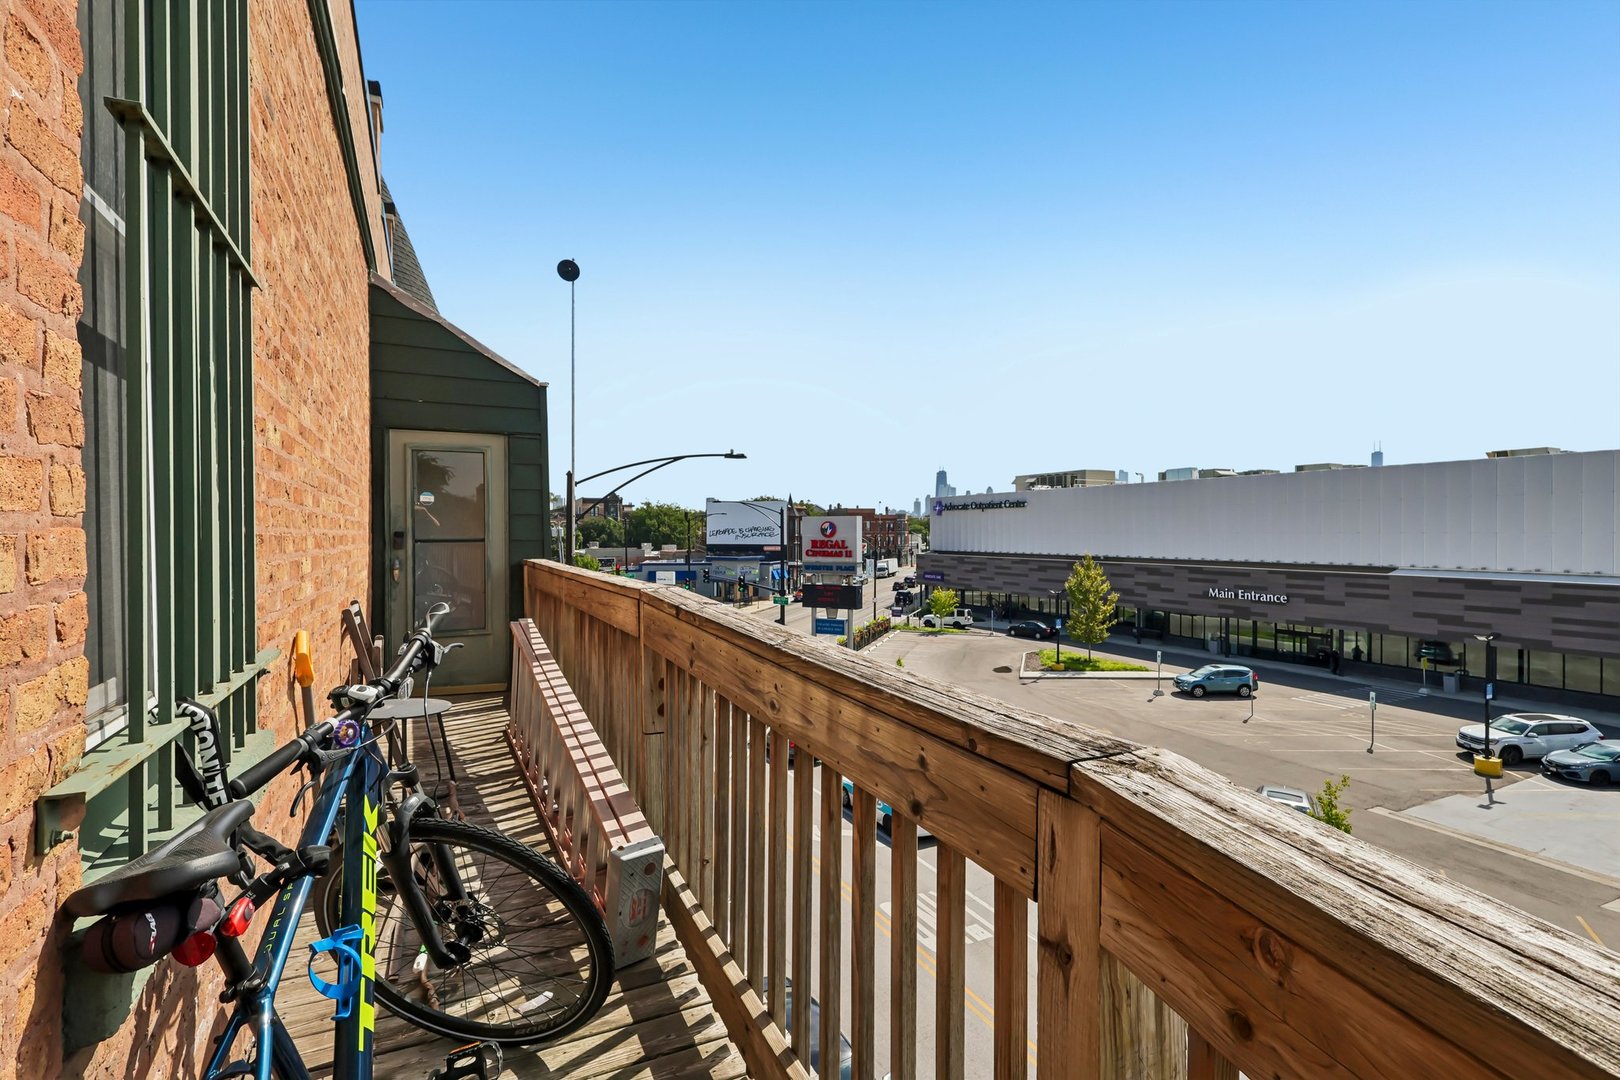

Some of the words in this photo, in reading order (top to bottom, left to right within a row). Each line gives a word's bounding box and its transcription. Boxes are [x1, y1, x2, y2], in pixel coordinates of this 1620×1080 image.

[943, 502, 970, 511] Advocate
[970, 501, 1003, 512] Outpatient
[1003, 500, 1027, 508] Center
[810, 539, 848, 549] REGAL
[1208, 587, 1235, 599] Main
[1238, 589, 1288, 604] Entrance
[358, 794, 379, 1052] TREK
